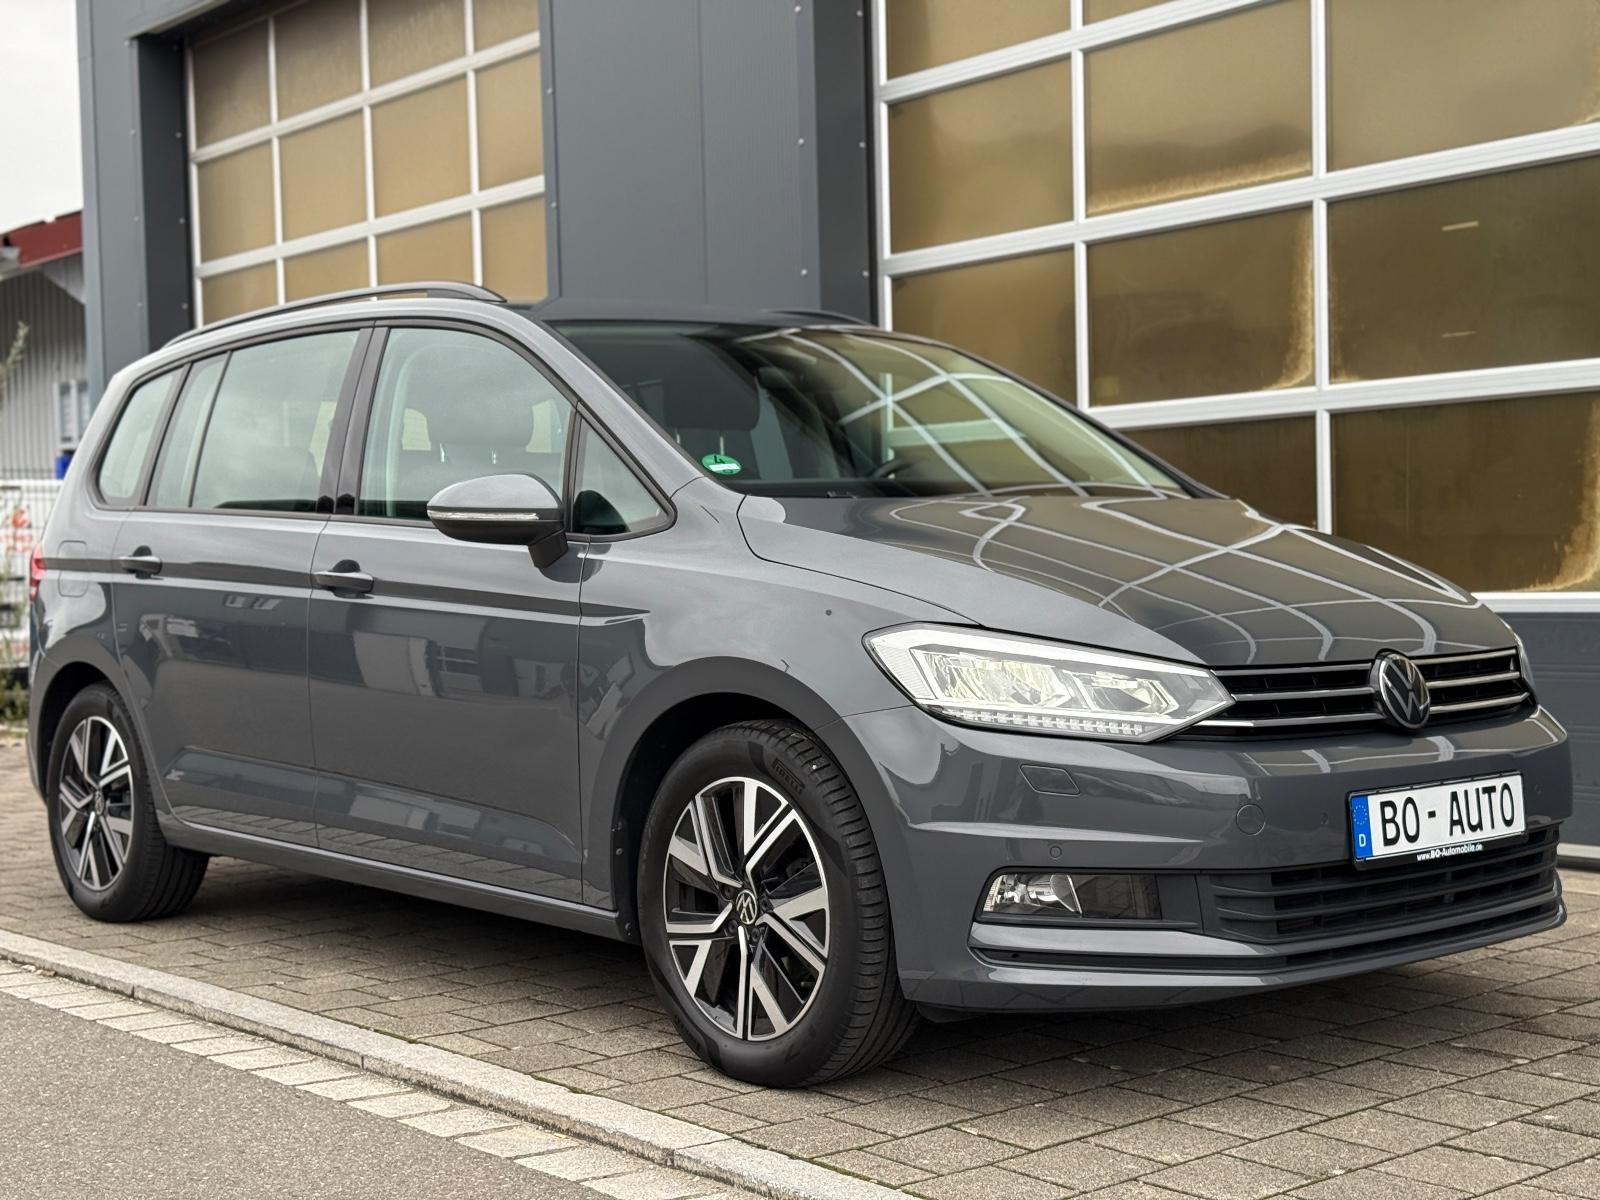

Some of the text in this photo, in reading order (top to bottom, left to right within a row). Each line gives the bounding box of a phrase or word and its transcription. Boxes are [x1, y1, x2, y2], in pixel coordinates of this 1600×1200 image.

[1379, 796, 1420, 847] BO
[1449, 782, 1515, 837] AUTO
[1358, 833, 1367, 848] D
[1416, 843, 1483, 861] www.BO-Automobile.de
